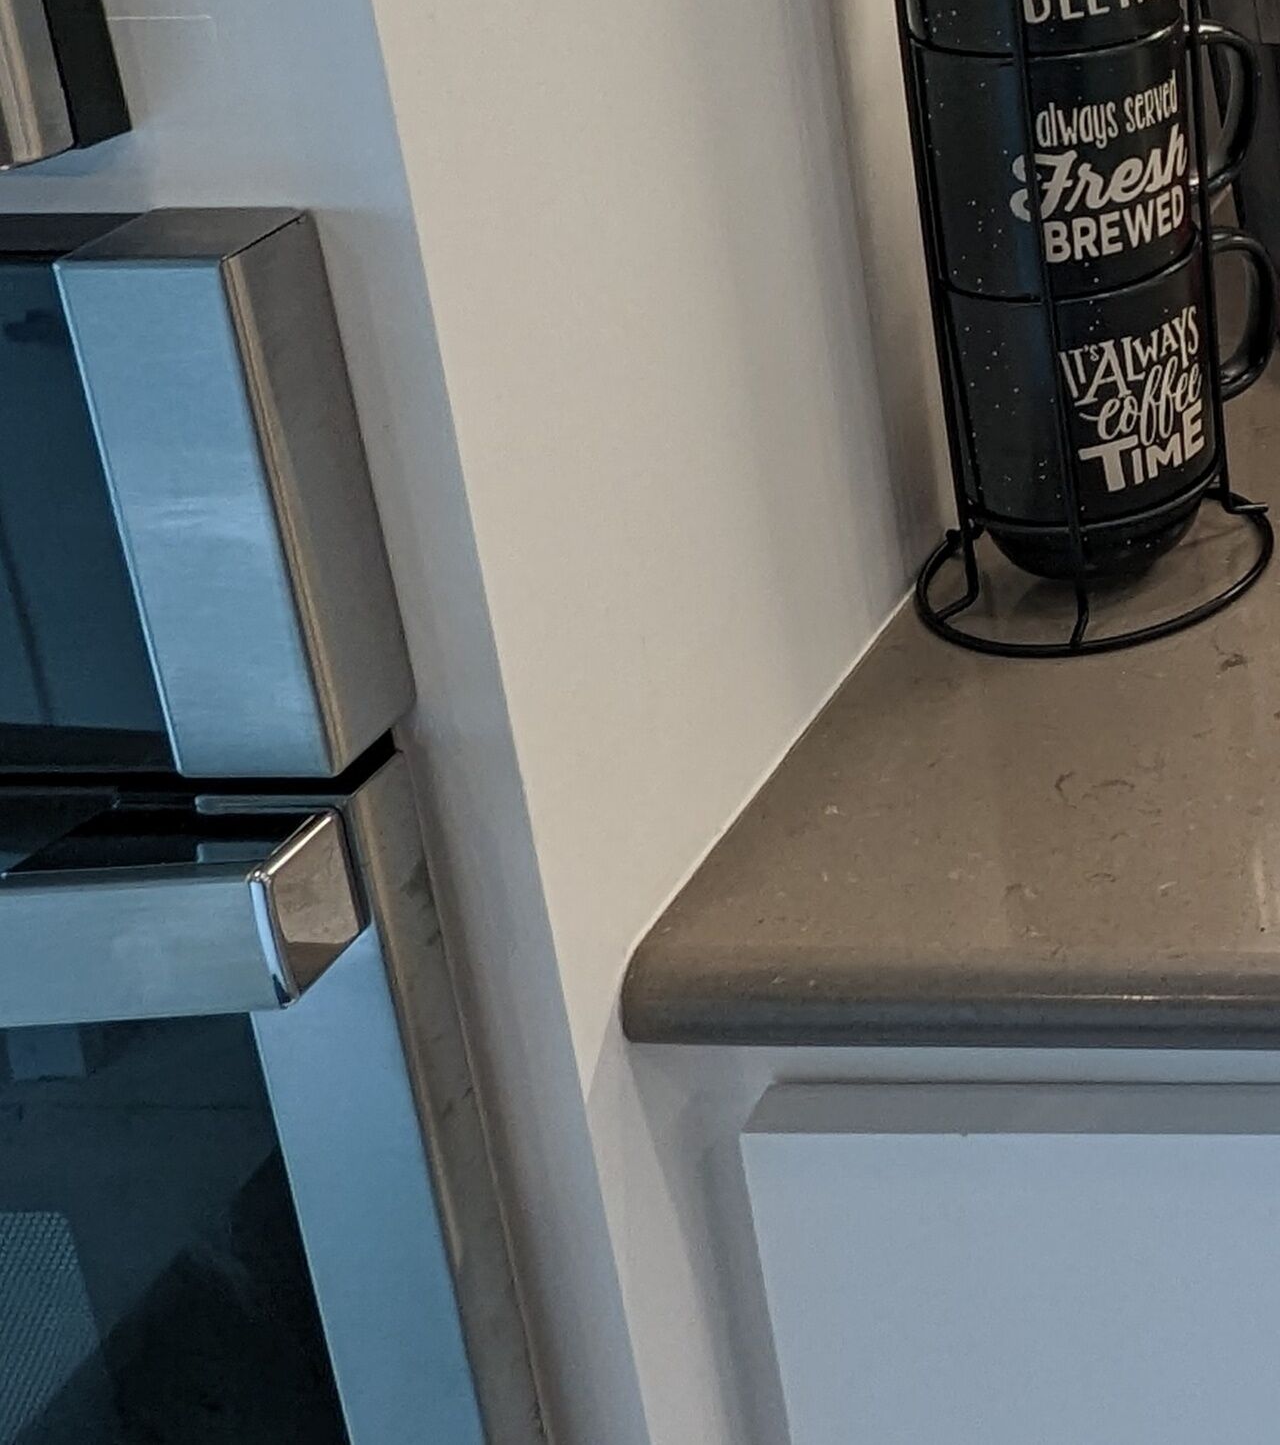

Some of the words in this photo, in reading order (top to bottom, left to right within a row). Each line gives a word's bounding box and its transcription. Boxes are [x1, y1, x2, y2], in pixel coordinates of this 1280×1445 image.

[1036, 102, 1119, 149] always
[1124, 69, 1179, 133] served
[1010, 123, 1189, 223] Fresh
[1043, 185, 1186, 264] BREWED
[1058, 344, 1100, 399] IT'S
[1075, 305, 1201, 407] ALWAYS
[1079, 355, 1202, 446] coffee
[1078, 399, 1205, 492] TIME
